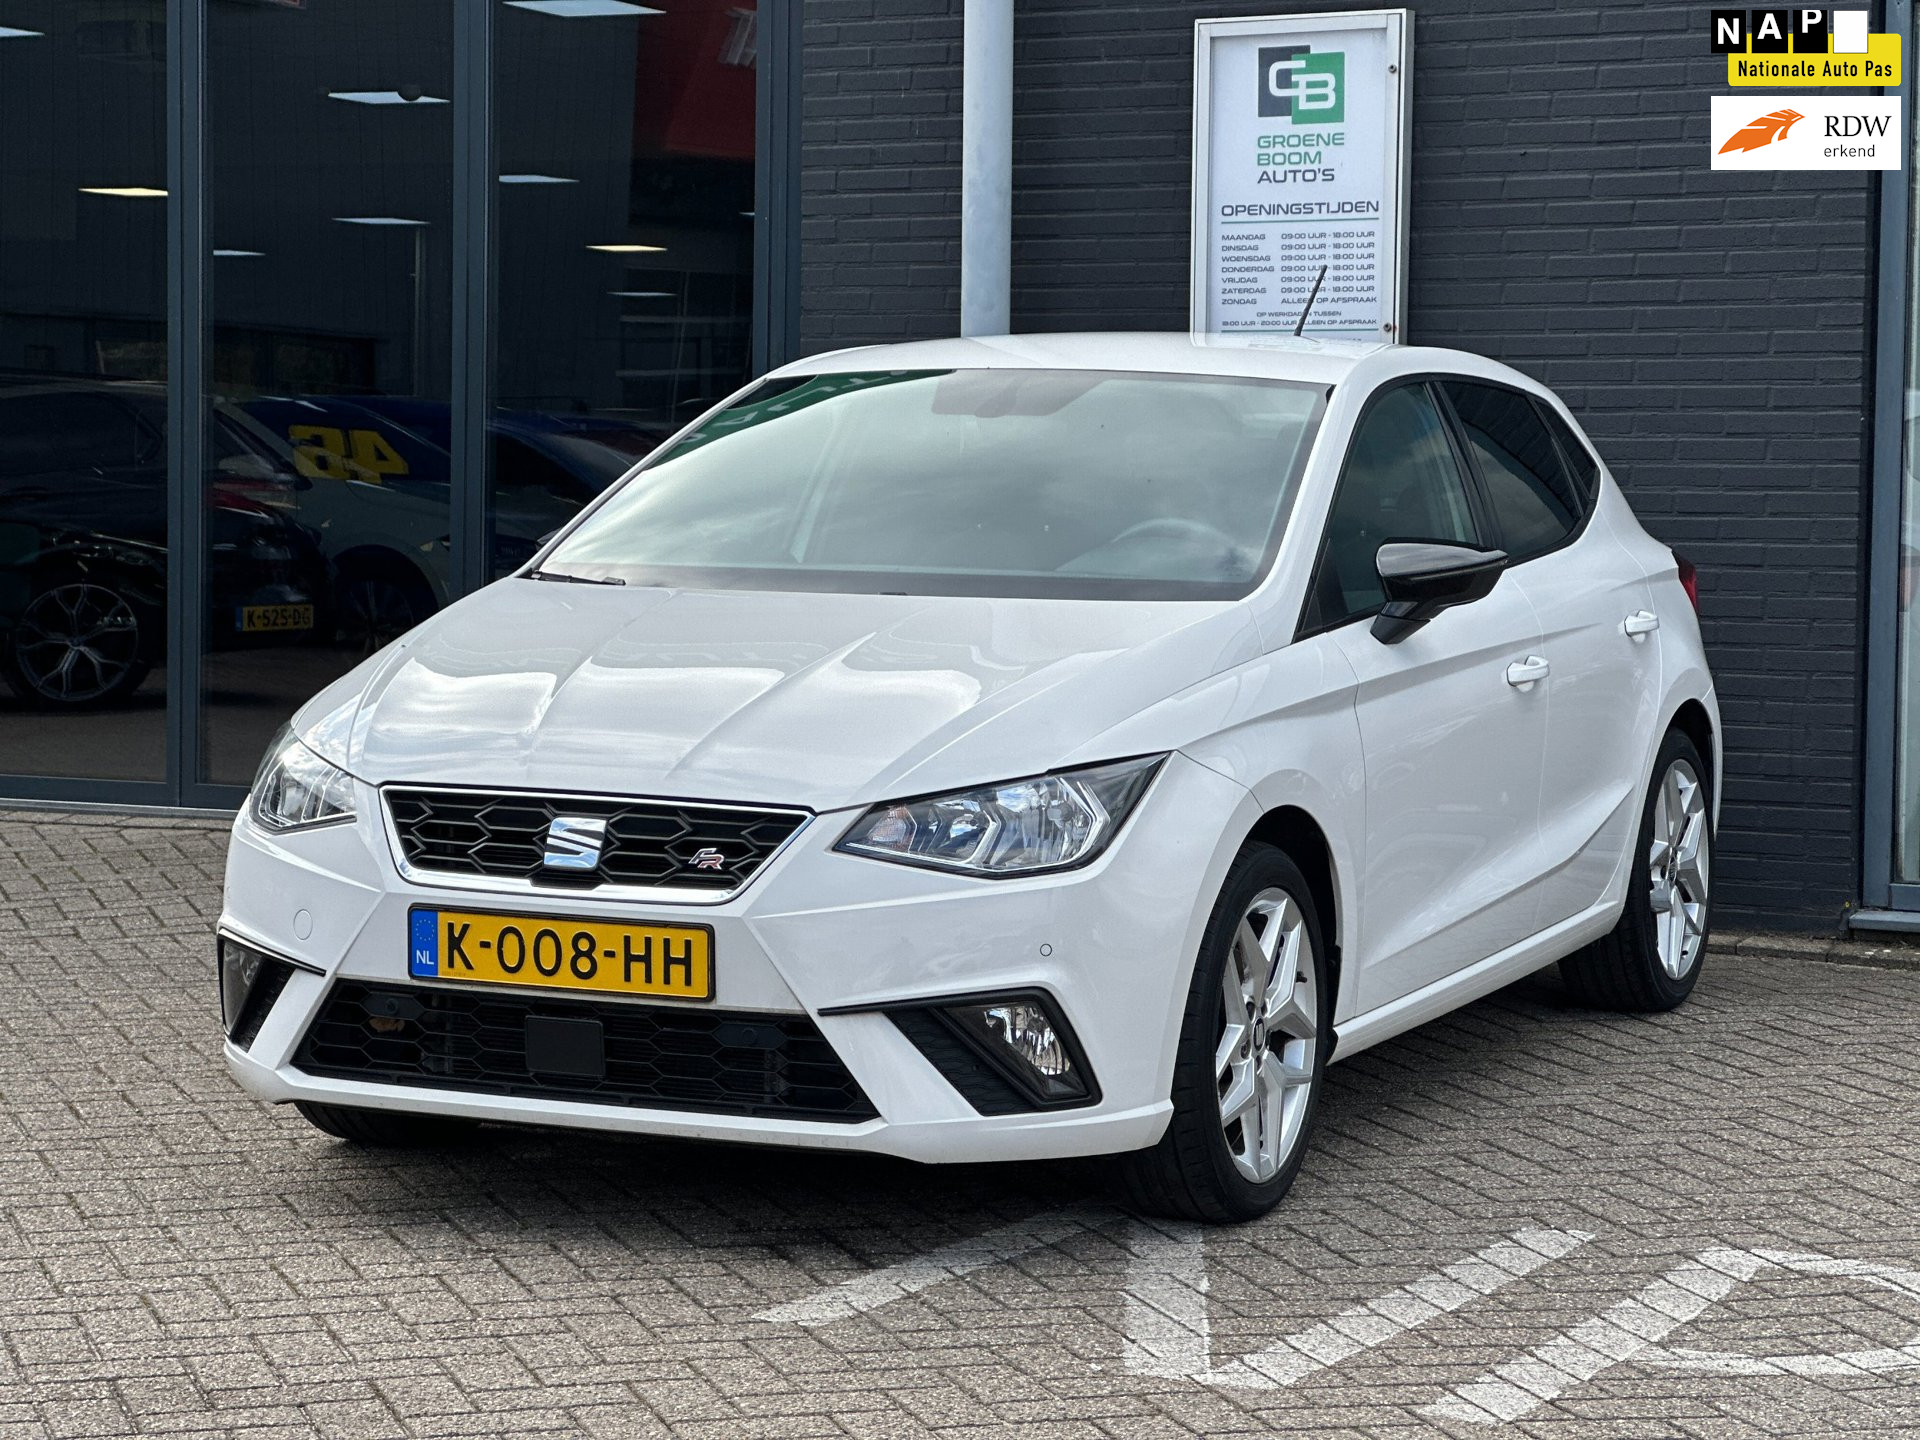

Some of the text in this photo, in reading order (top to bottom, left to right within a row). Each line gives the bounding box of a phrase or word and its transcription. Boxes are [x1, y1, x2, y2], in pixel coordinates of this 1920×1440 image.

[1257, 132, 1345, 149] GROENE
[1257, 151, 1322, 166] BOOM
[1257, 168, 1335, 184] AUTO'S
[1221, 201, 1379, 216] OPENINGSTIJDEN
[1221, 233, 1266, 241] MAANDAG
[1281, 232, 1306, 240] 09:00
[1333, 231, 1355, 239] 18:00
[1356, 230, 1375, 238] UUR
[1221, 244, 1259, 252] DINSDAG
[1281, 243, 1306, 251] 09:00
[1221, 265, 1274, 273] DONDERDAG
[1221, 276, 1258, 284] VRIJDAG
[1221, 287, 1267, 295] ZATERDAG
[1330, 296, 1377, 304] AFSPRAAK
[688, 847, 724, 869] FR
[416, 949, 434, 965] NL
[447, 921, 693, 987] K-008-HH
